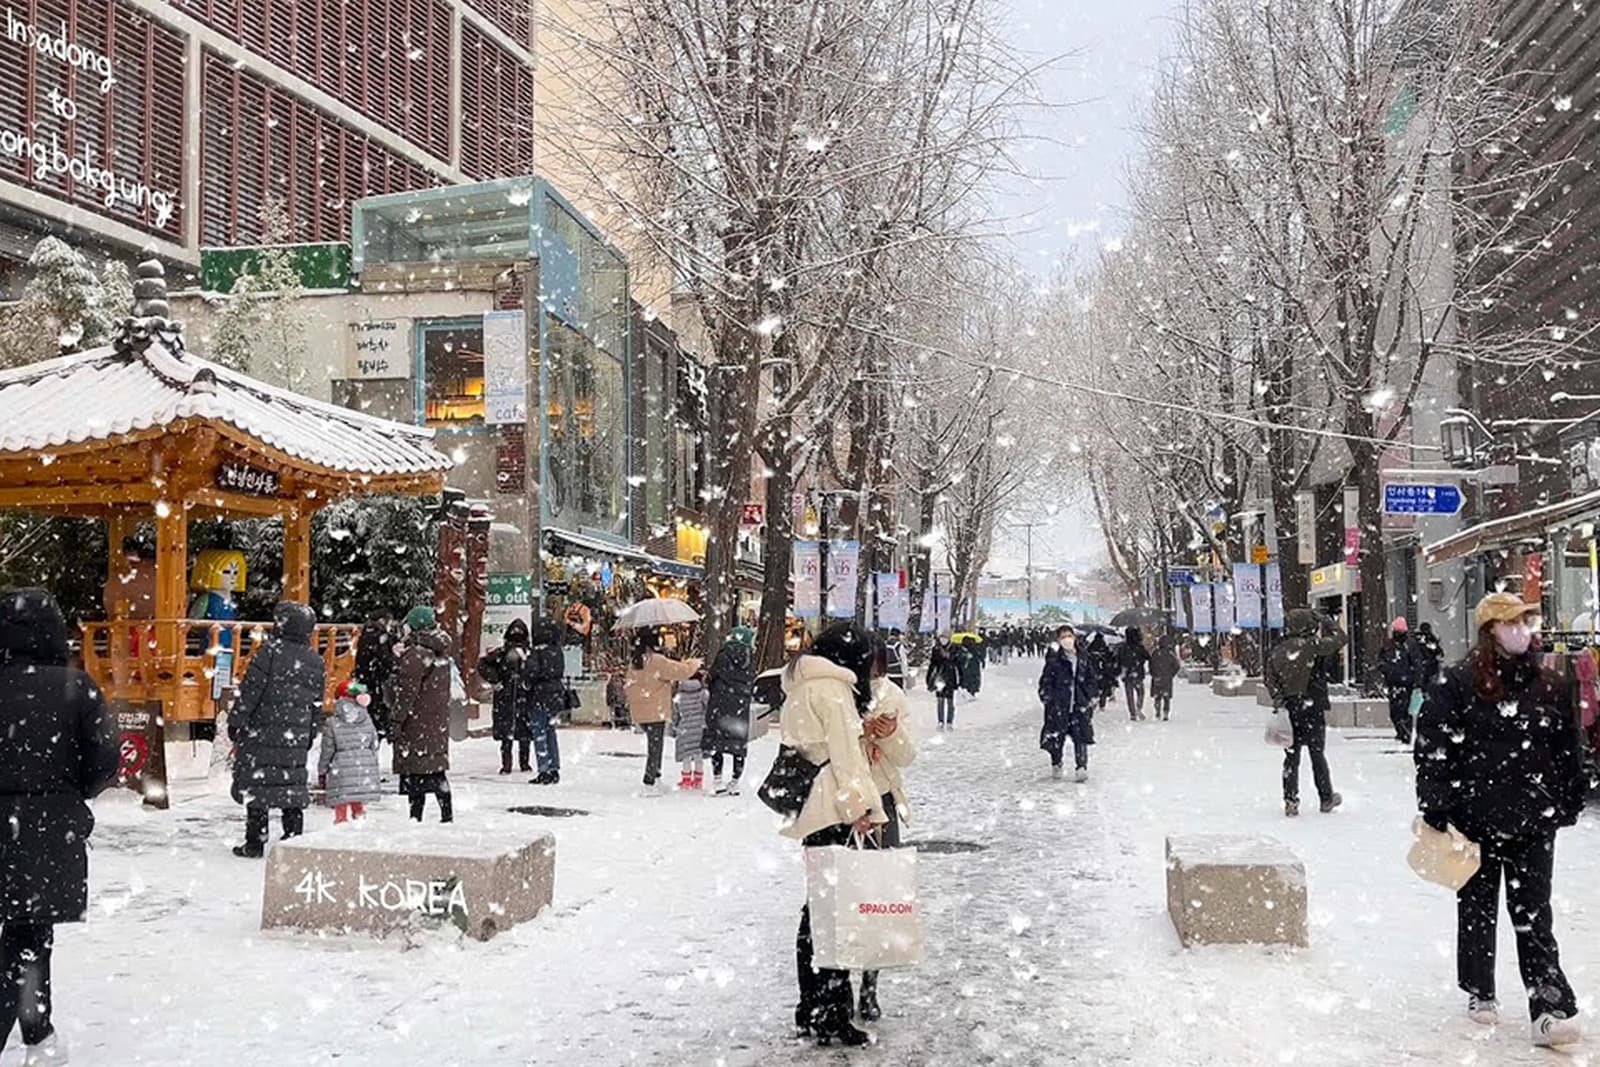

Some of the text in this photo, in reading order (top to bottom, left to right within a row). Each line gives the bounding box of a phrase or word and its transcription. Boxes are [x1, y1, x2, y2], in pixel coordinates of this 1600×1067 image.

[6, 6, 117, 95] Insadong
[47, 87, 78, 120] to
[505, 591, 529, 604] out
[358, 874, 469, 916] KOREA
